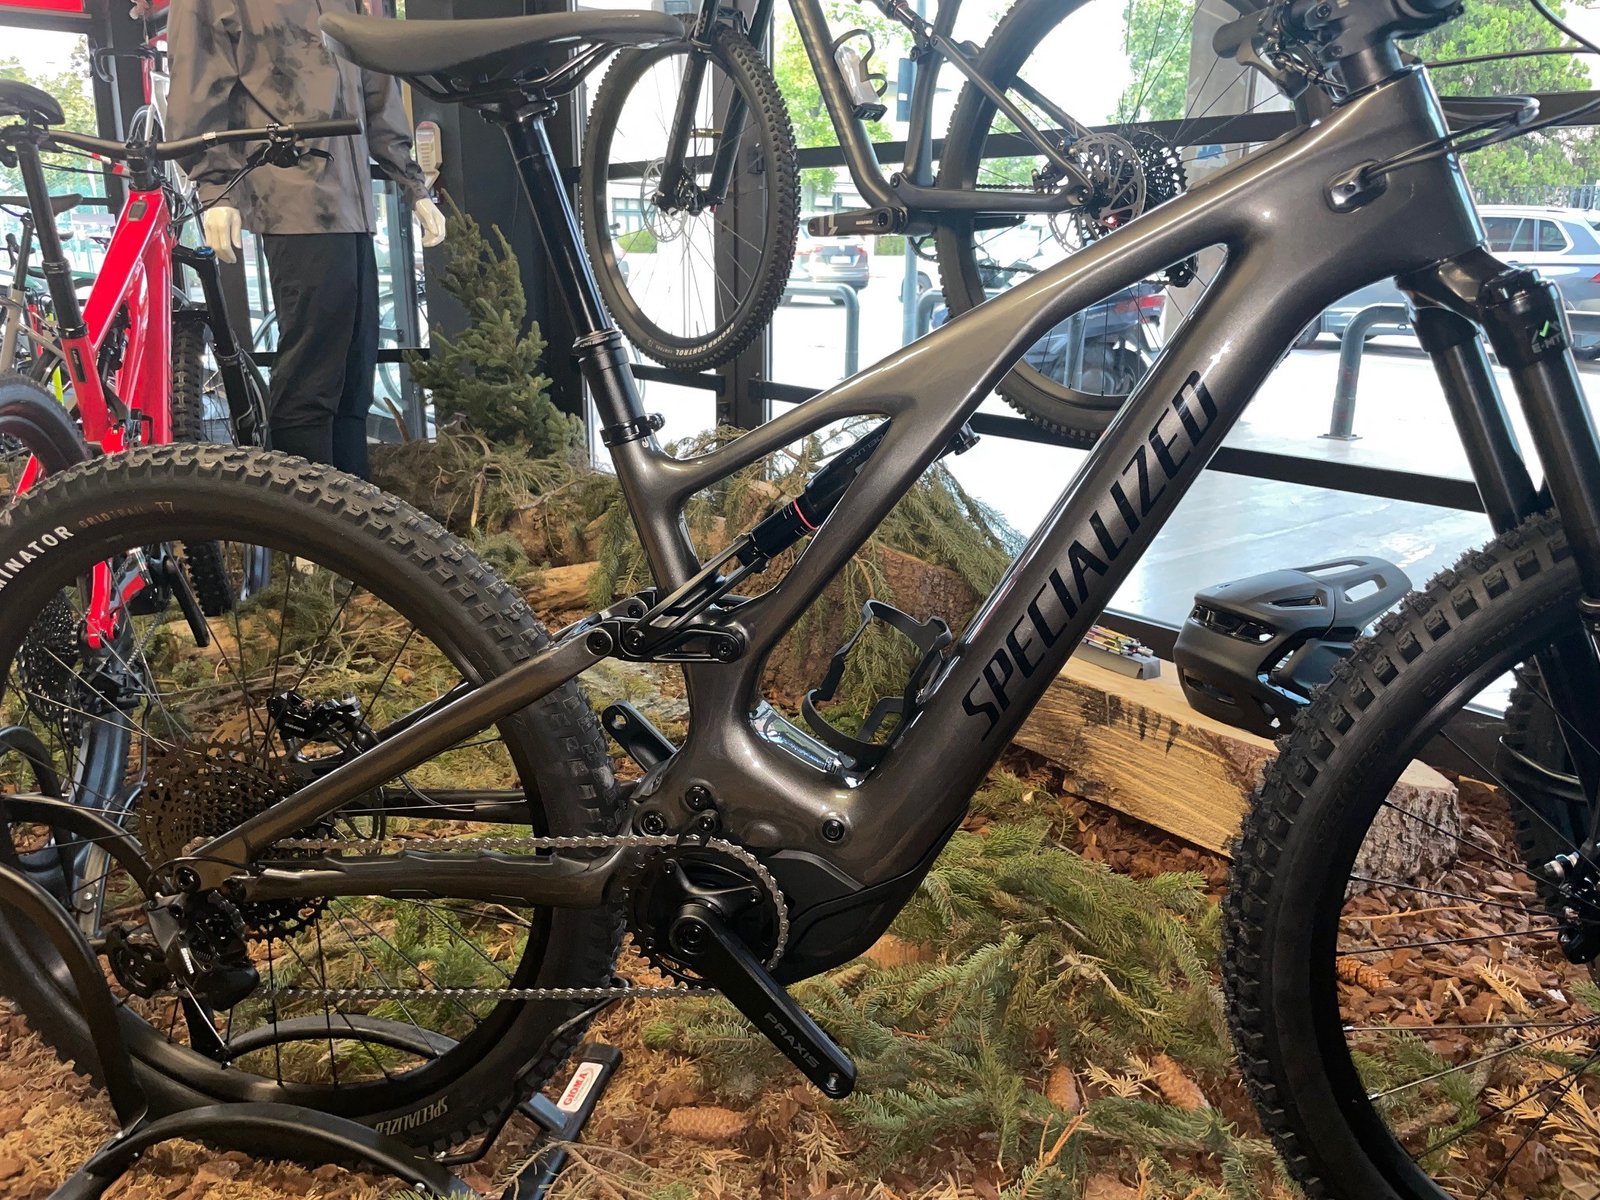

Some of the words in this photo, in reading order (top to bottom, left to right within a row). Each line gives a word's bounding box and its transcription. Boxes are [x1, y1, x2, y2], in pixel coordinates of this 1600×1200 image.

[961, 370, 1218, 742] SPECIALIZED
[763, 1012, 821, 1069] PRAXIS
[563, 1072, 589, 1106] GIOMA
[375, 1095, 449, 1137] SPECIALIZED
